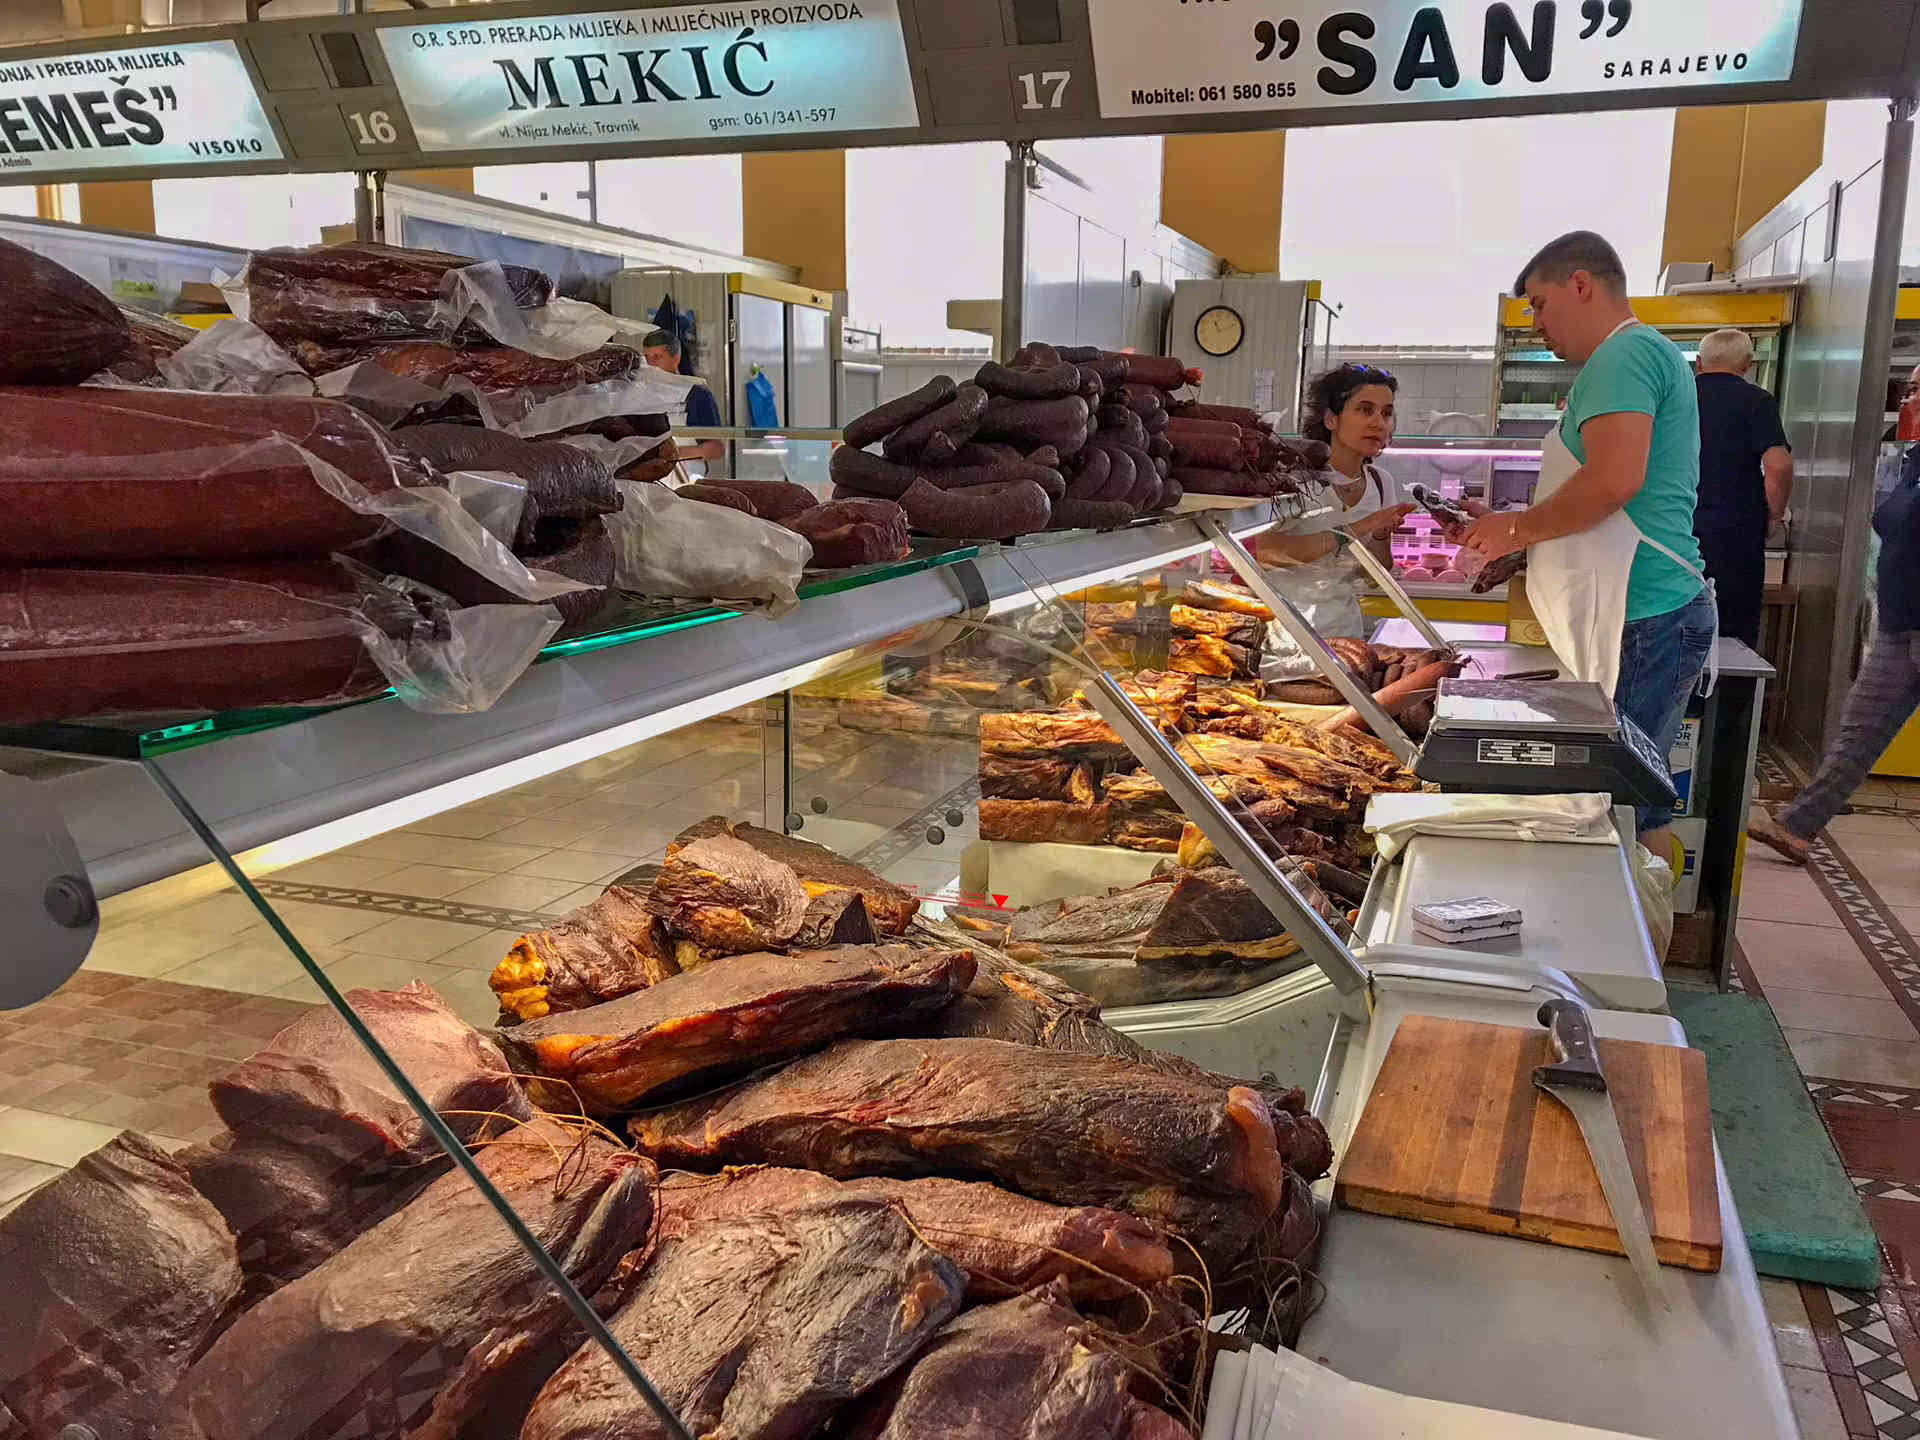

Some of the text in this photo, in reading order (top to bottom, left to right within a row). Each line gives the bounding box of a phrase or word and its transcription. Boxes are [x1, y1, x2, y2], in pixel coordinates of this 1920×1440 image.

[412, 3, 863, 48] O.R. S.P.D. PRERADA MLIJEKA I MLIJEČNIH PROIZVODA
[37, 64, 45, 79] I
[47, 58, 117, 78] PRERADA
[120, 51, 184, 72] MLIJEKA
[492, 27, 775, 111] MEKIĆ
[1604, 53, 1748, 79] SARAJEVO
[1018, 71, 1071, 110] 17
[1131, 82, 1296, 105] Mobitel: 061 580 855
[349, 111, 397, 145] 16
[594, 119, 640, 135] Travnik
[709, 108, 837, 132] gsm: 061/341-597
[189, 138, 262, 157] VISOKO
